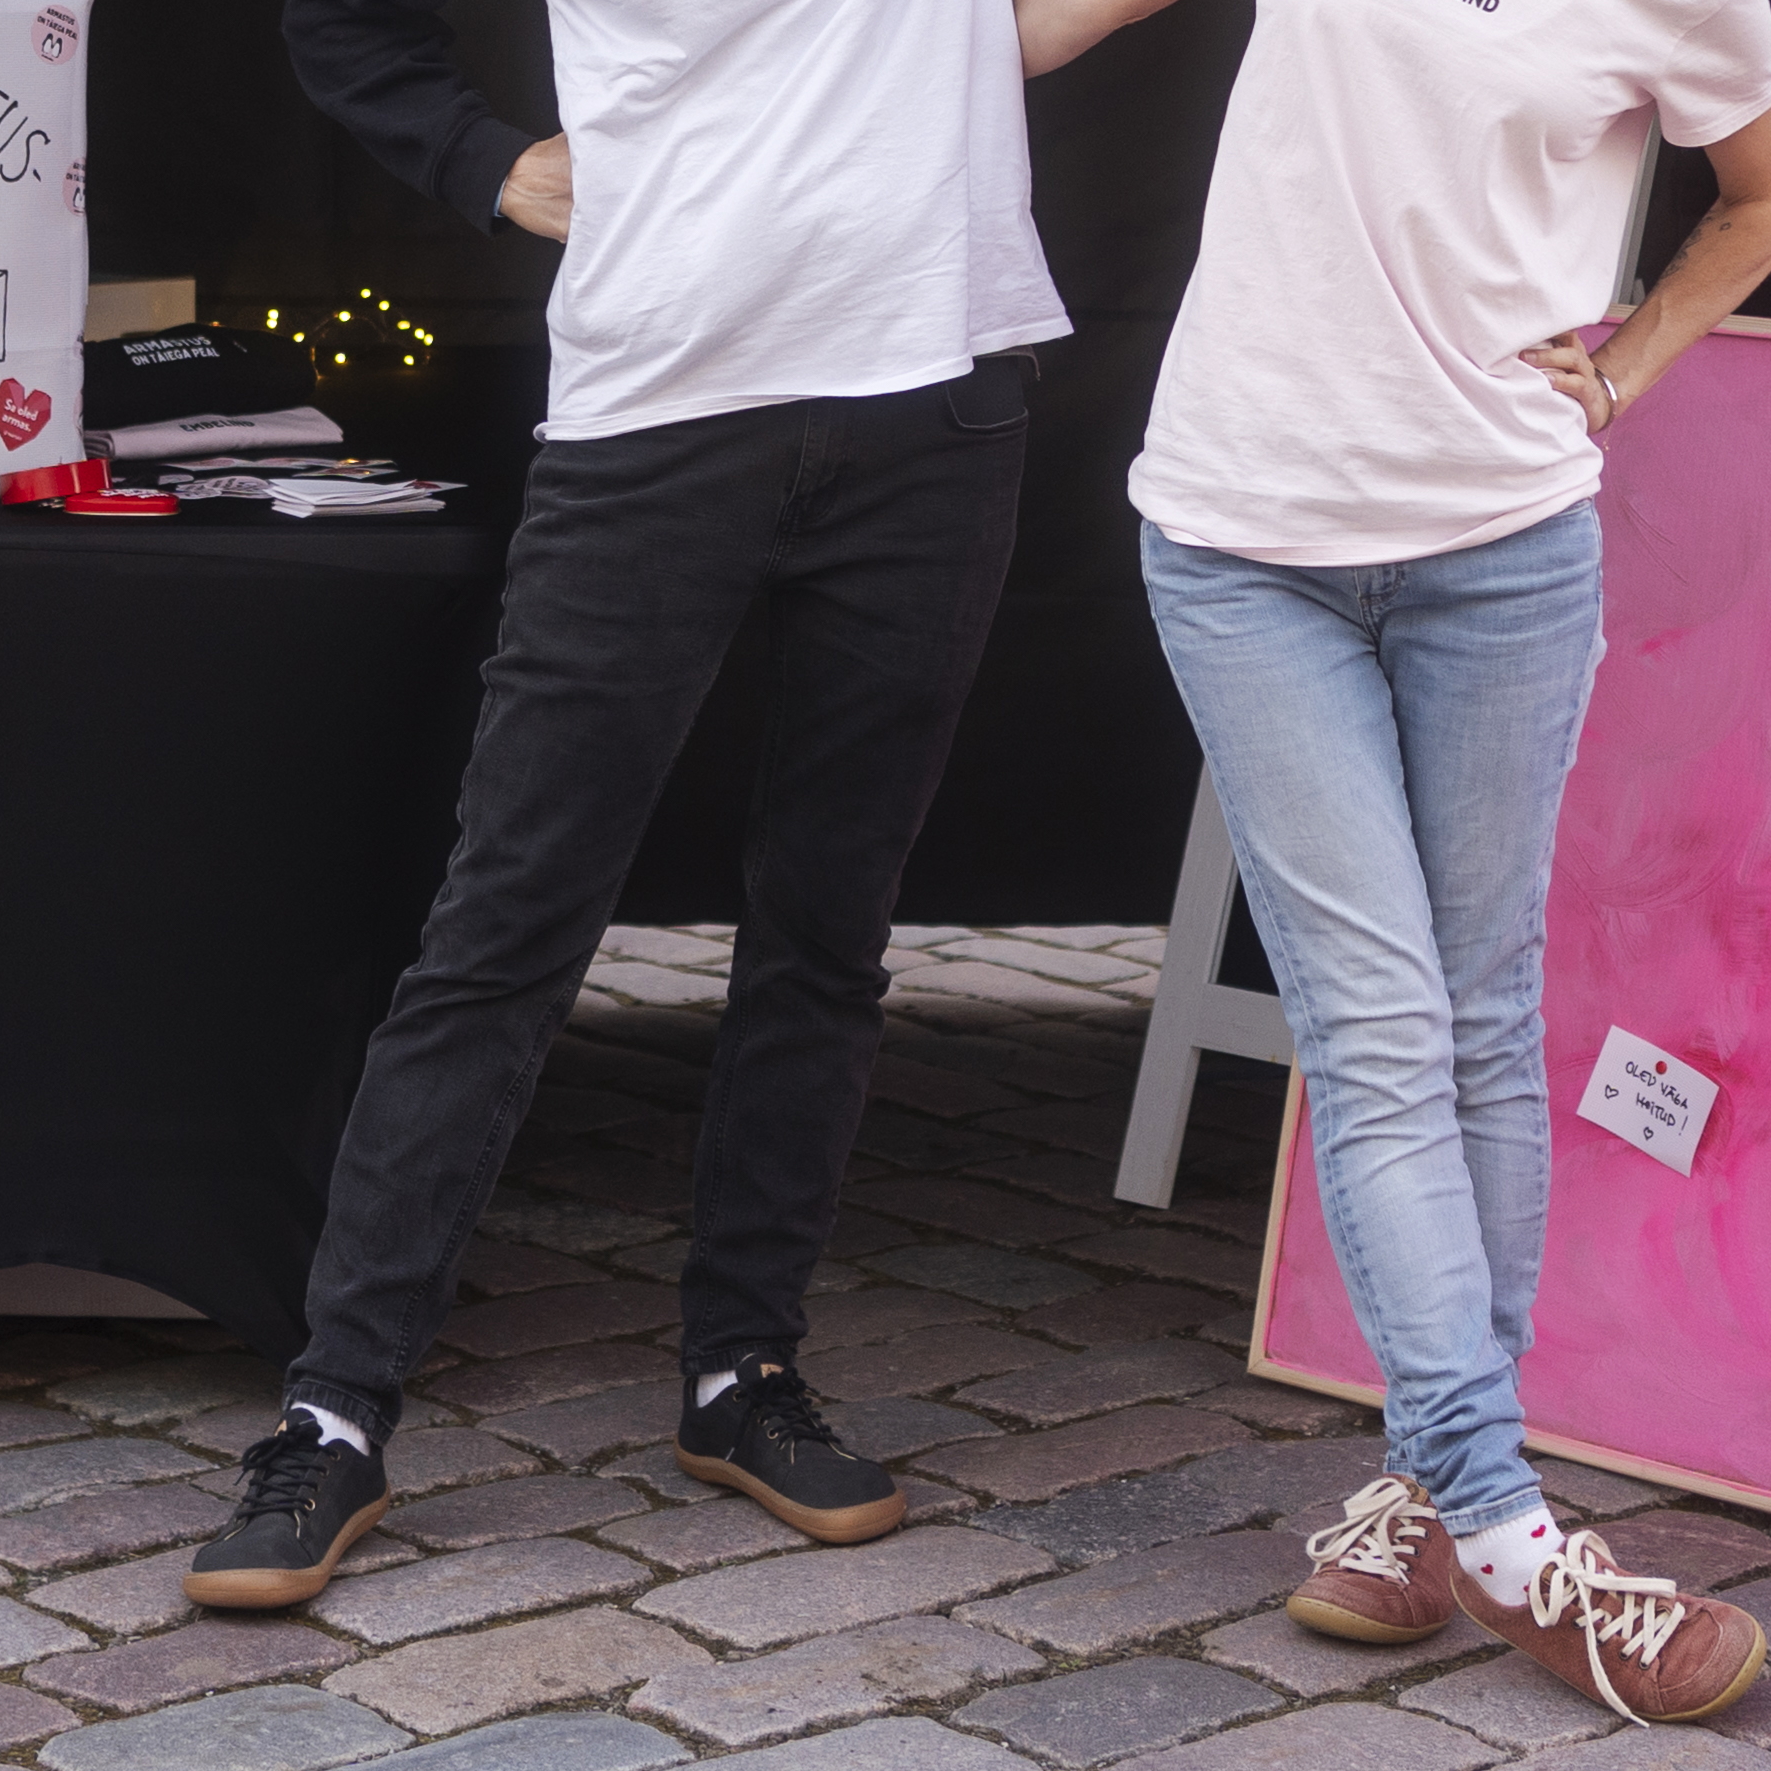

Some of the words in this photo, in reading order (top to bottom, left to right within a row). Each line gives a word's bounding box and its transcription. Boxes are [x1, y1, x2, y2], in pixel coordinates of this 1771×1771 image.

[122, 336, 212, 355] ARMASTUS
[132, 354, 150, 366] ON
[150, 348, 191, 363] TÄIEGA
[191, 346, 220, 359] PEAL
[4, 398, 16, 413] Sa
[17, 406, 39, 421] oled
[179, 419, 255, 432] EMBELIND
[1625, 1061, 1657, 1087] OLED
[1660, 1081, 1688, 1110] VÄGA
